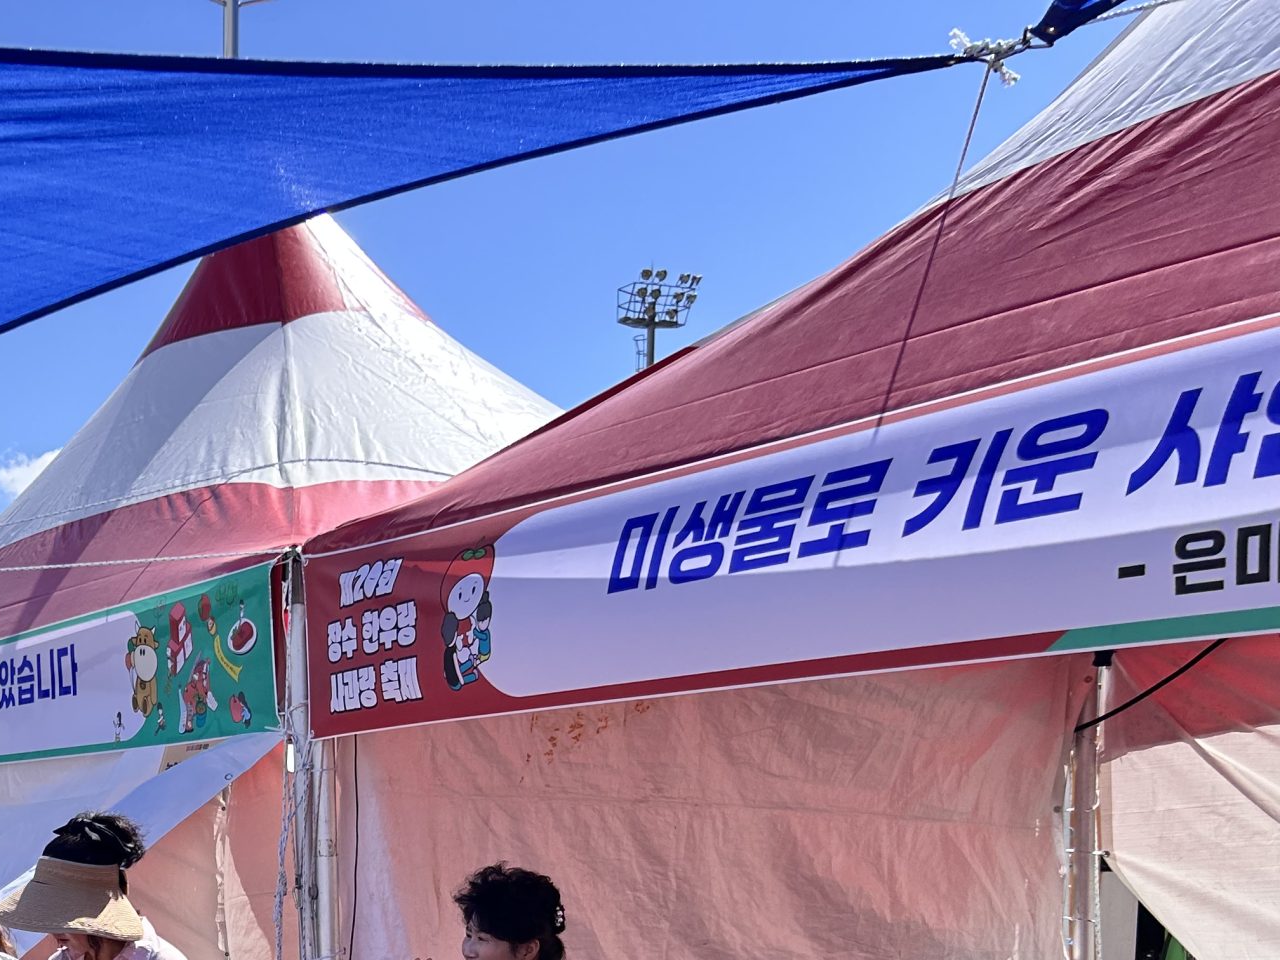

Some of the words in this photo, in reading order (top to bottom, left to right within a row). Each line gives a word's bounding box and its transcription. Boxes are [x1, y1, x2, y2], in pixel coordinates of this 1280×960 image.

[606, 457, 893, 595] 미생물로
[902, 407, 1110, 537] 키운
[327, 617, 357, 663] 장수
[362, 600, 418, 654] 한우랑
[330, 665, 378, 713] 사과랑
[380, 656, 423, 703] 축제
